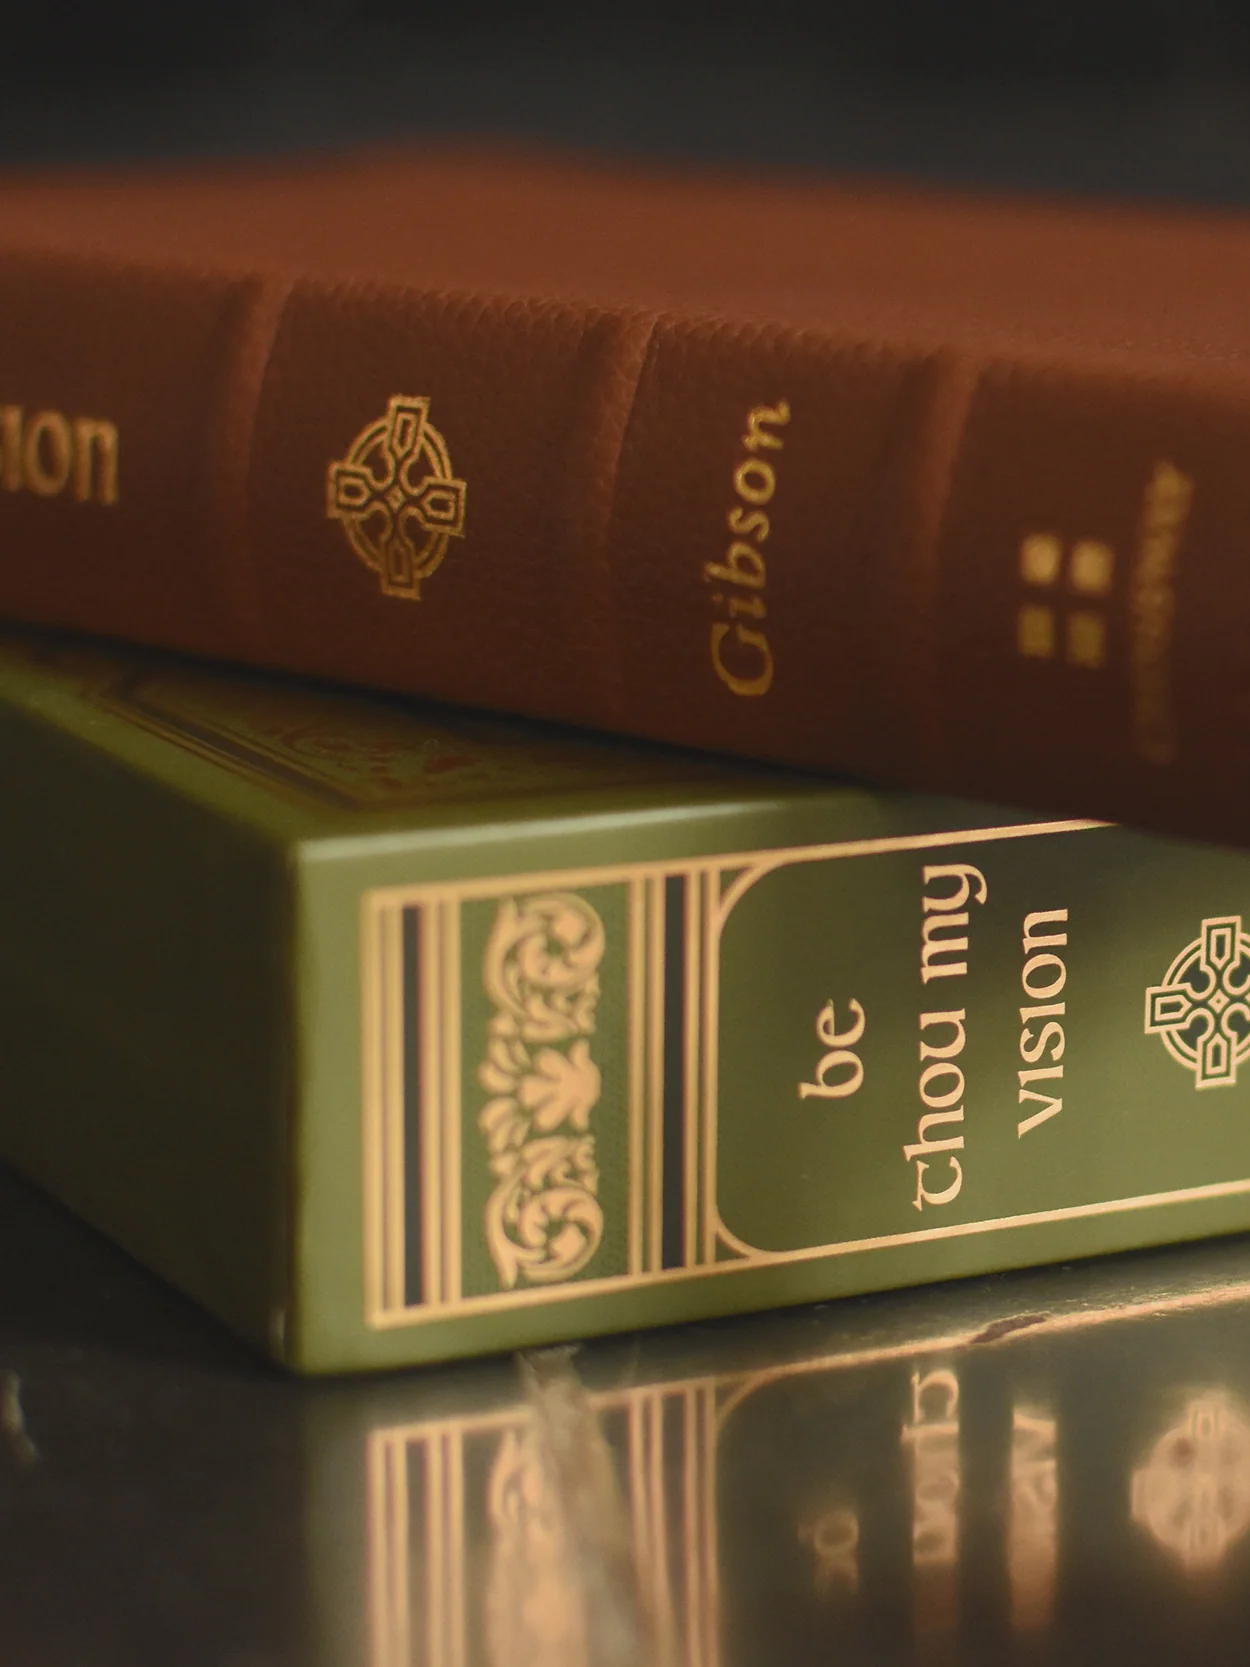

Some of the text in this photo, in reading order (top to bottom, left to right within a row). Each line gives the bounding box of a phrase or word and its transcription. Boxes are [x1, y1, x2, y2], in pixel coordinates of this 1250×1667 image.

[0, 404, 119, 505] ion
[704, 399, 791, 696] Gibson
[799, 998, 866, 1100] be
[903, 863, 988, 1212] thou my
[1017, 908, 1069, 1139] vision
